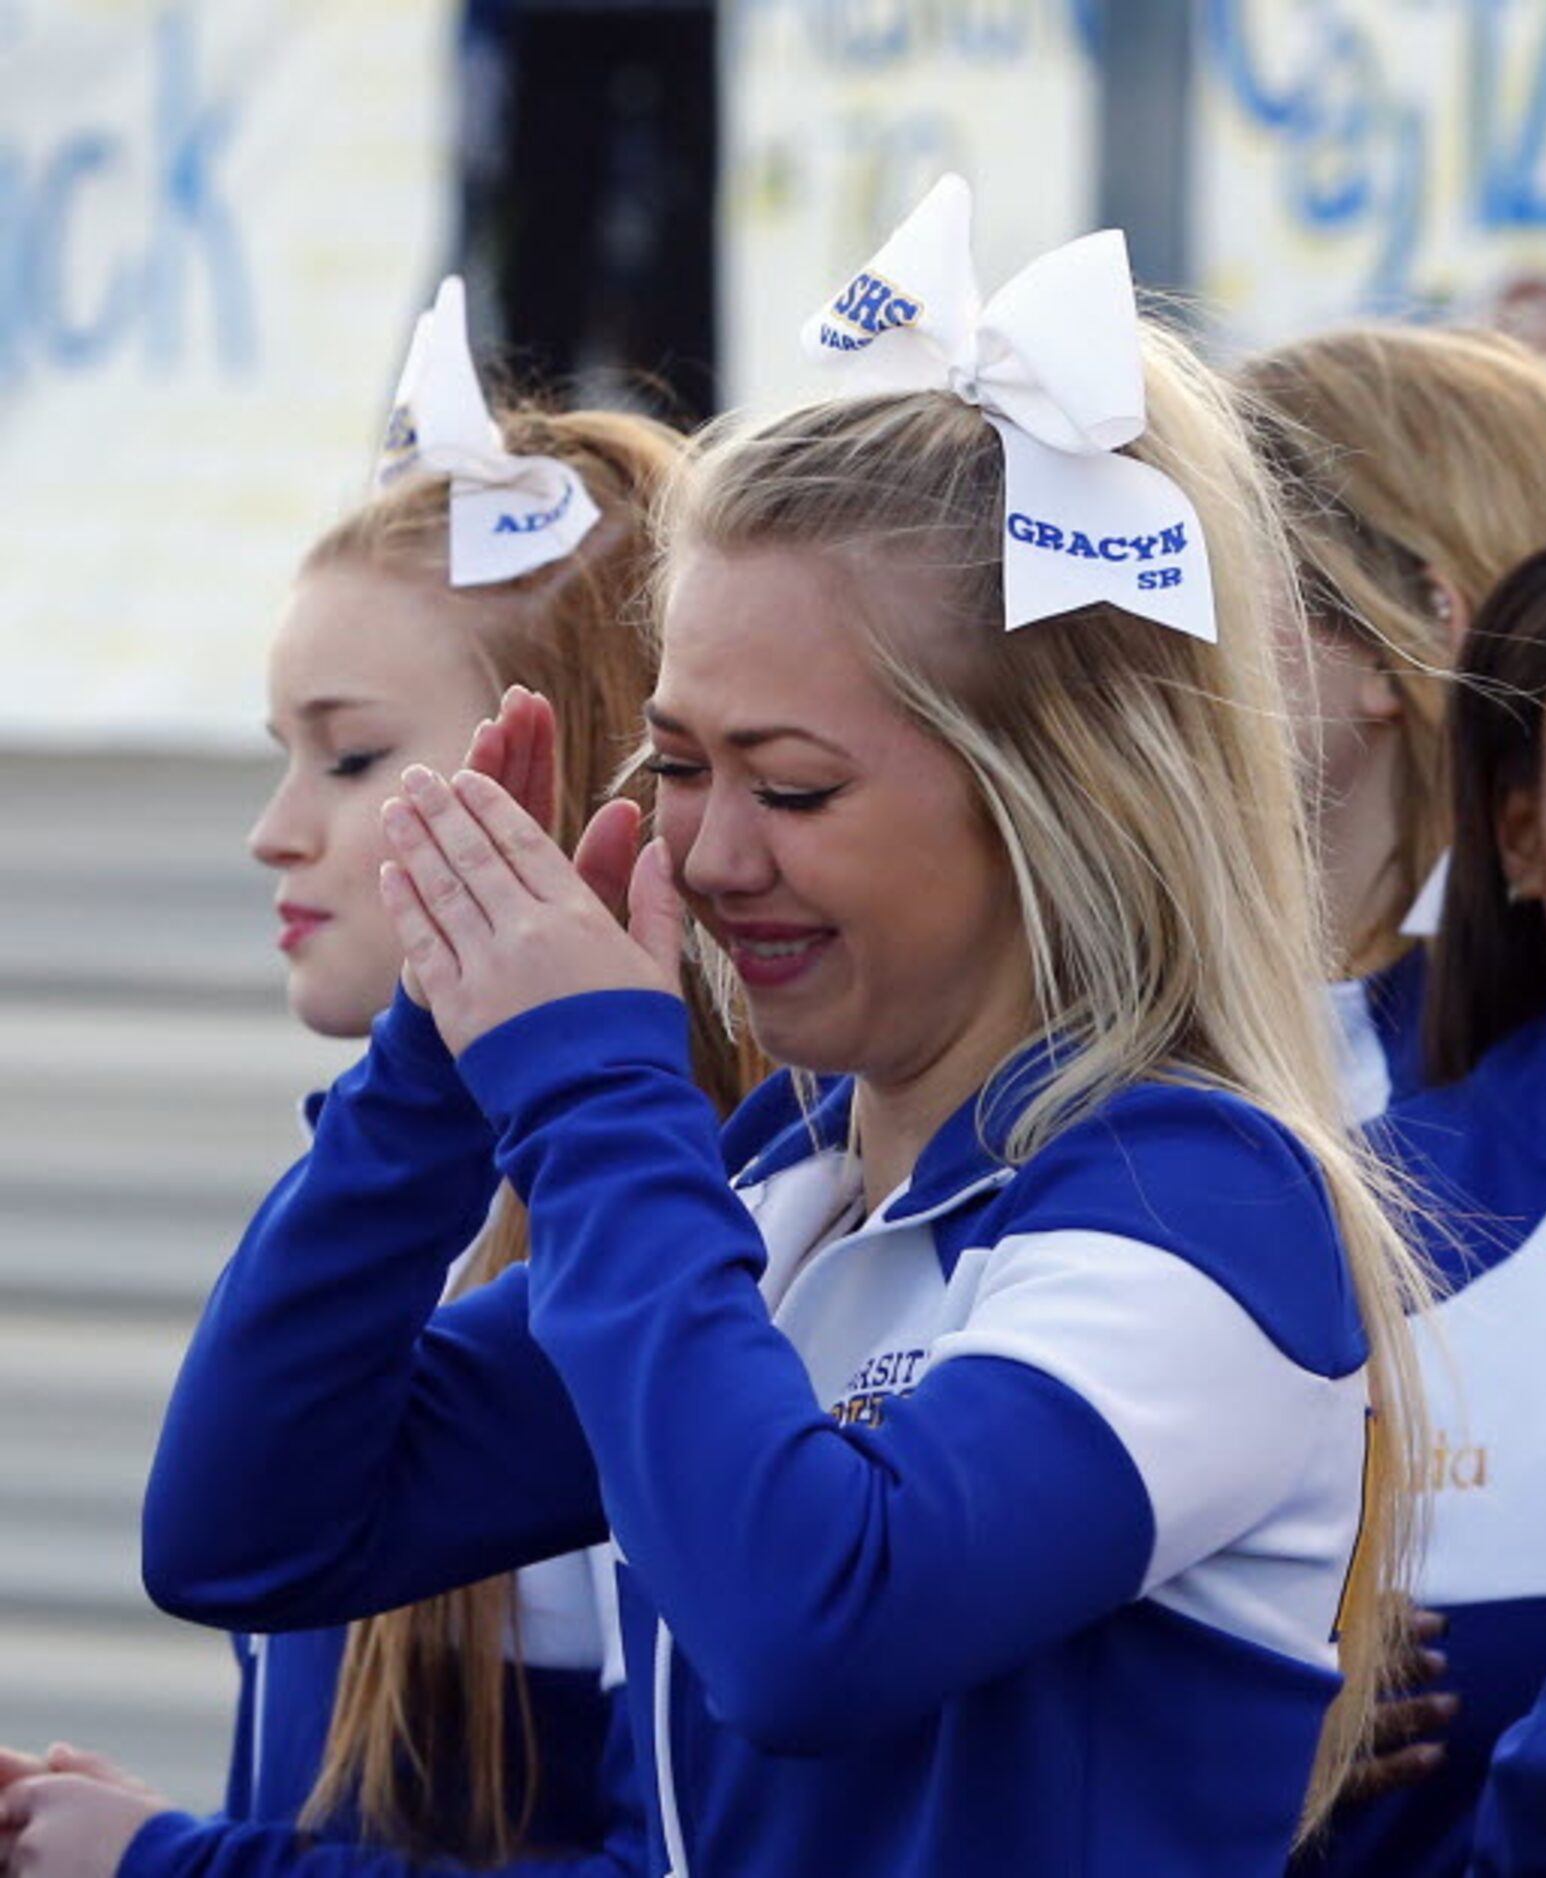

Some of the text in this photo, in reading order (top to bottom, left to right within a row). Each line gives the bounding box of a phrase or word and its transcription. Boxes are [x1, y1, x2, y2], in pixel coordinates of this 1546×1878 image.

[833, 272, 921, 332] SHS
[1007, 512, 1187, 562] GRACYN
[1136, 567, 1183, 591] SR
